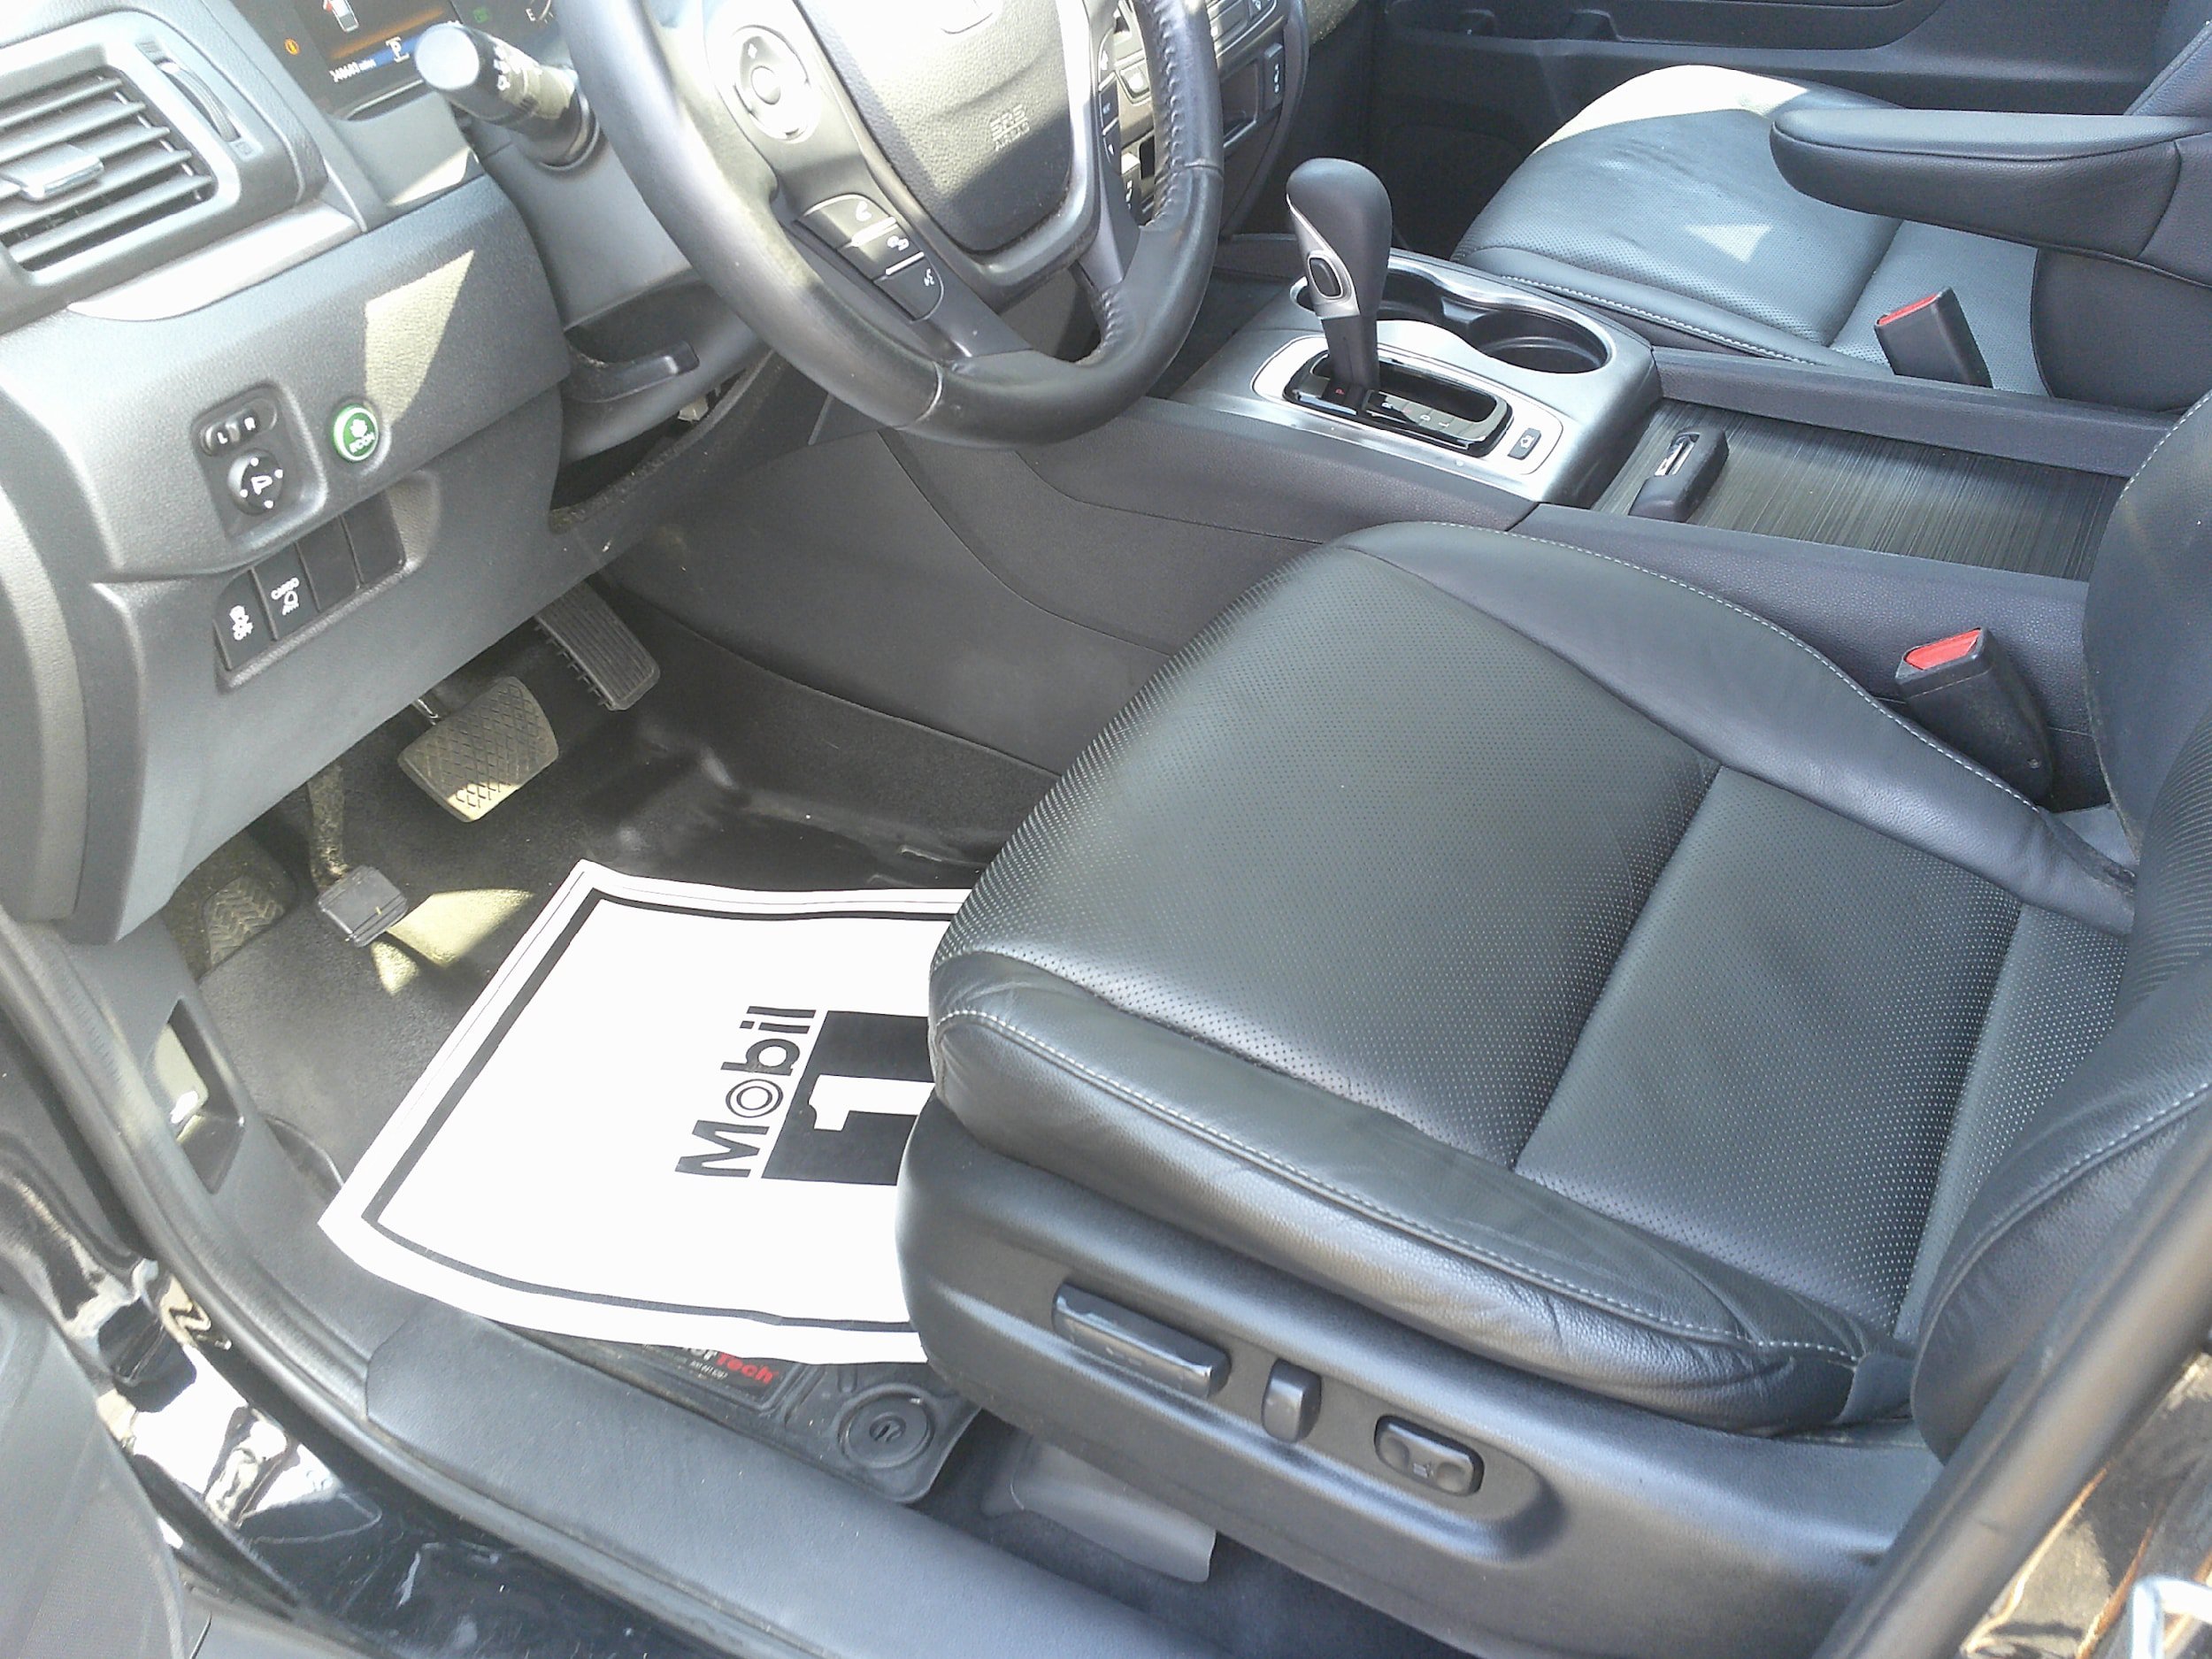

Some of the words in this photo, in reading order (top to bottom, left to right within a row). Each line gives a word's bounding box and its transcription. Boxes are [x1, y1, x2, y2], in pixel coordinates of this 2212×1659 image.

[526, 8, 536, 21] E
[990, 104, 1025, 136] SRS
[217, 432, 228, 444] L
[244, 417, 256, 431] R
[674, 1005, 817, 1178] Mobil
[808, 1073, 935, 1133] 1
